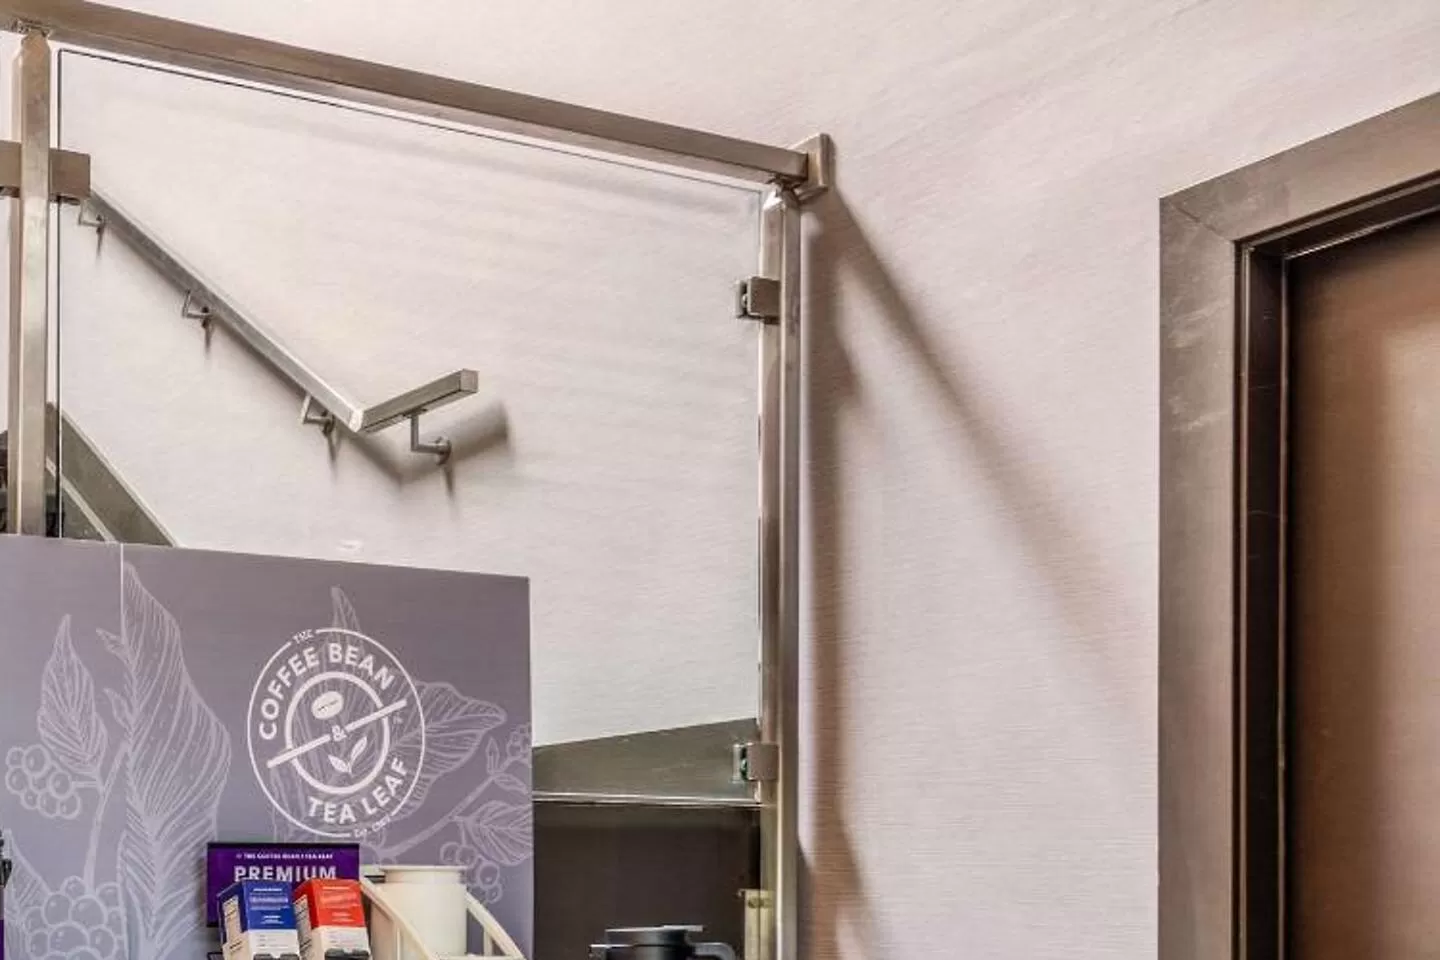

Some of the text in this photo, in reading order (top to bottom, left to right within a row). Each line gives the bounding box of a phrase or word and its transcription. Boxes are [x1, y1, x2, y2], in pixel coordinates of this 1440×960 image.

[259, 643, 395, 740] COFFEE BEAN
[331, 724, 347, 742] &
[308, 757, 408, 824] TEA LEAF
[234, 865, 337, 882] PREMIUM
